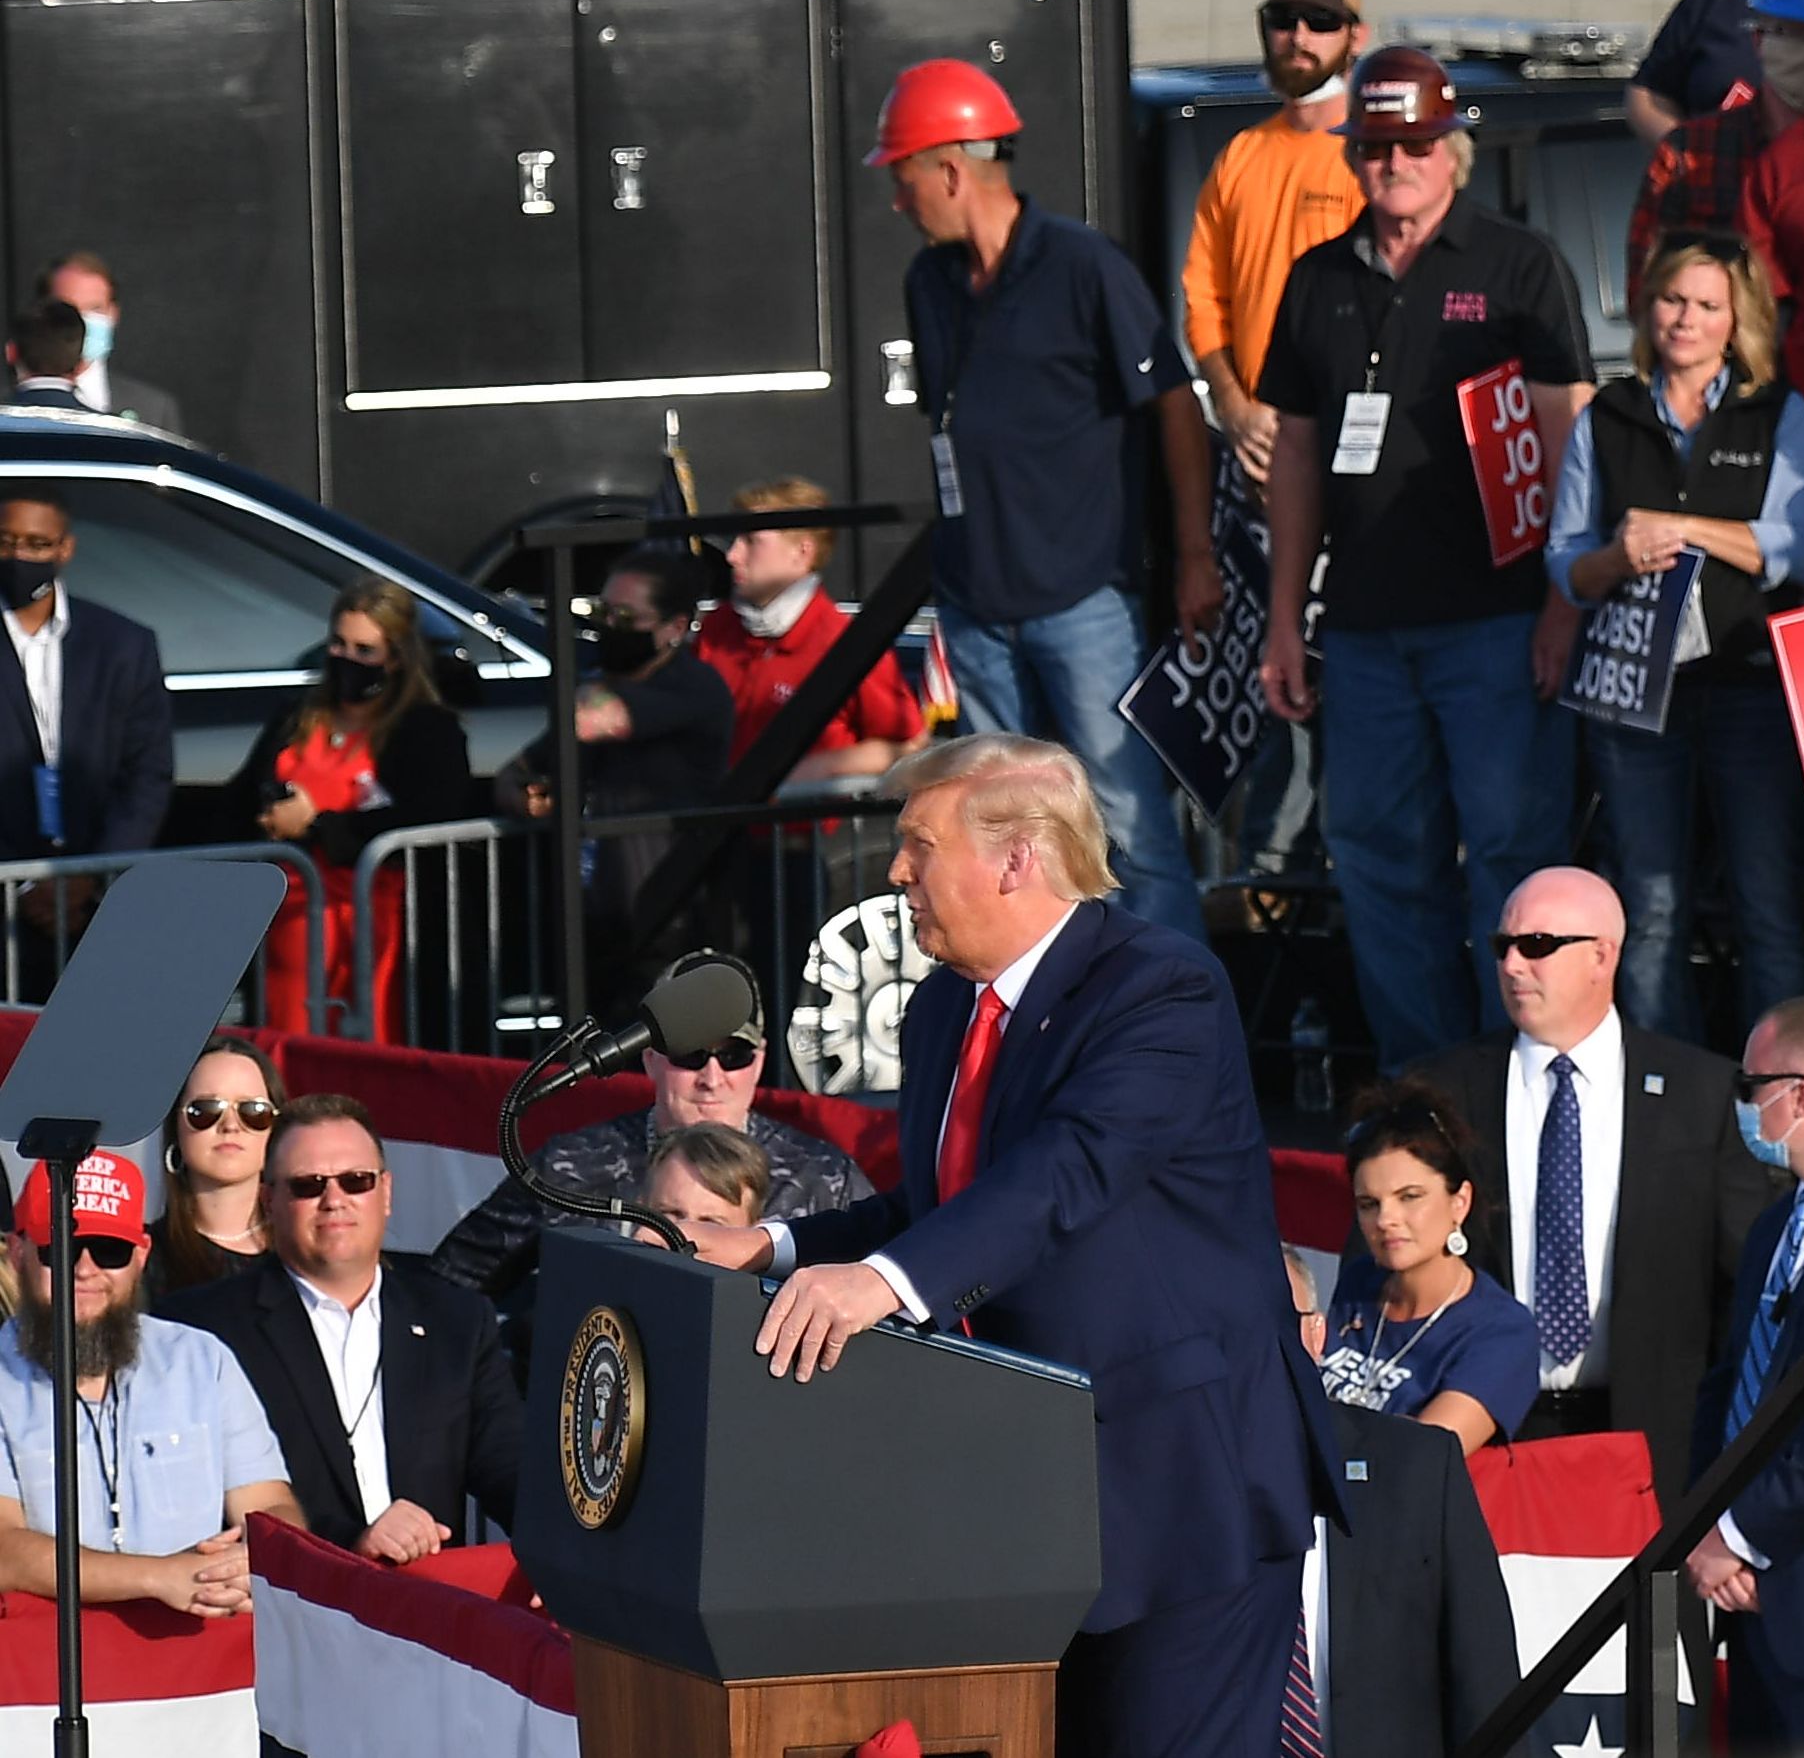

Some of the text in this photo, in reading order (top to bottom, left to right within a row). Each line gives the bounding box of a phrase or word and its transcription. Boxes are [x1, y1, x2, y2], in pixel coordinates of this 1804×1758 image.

[1586, 601, 1656, 658] JOBS!
[1573, 651, 1648, 712] JOBS!
[73, 1192, 120, 1217] REAT
[75, 1173, 131, 1202] ERICA
[1320, 1346, 1413, 1390] JESUS
